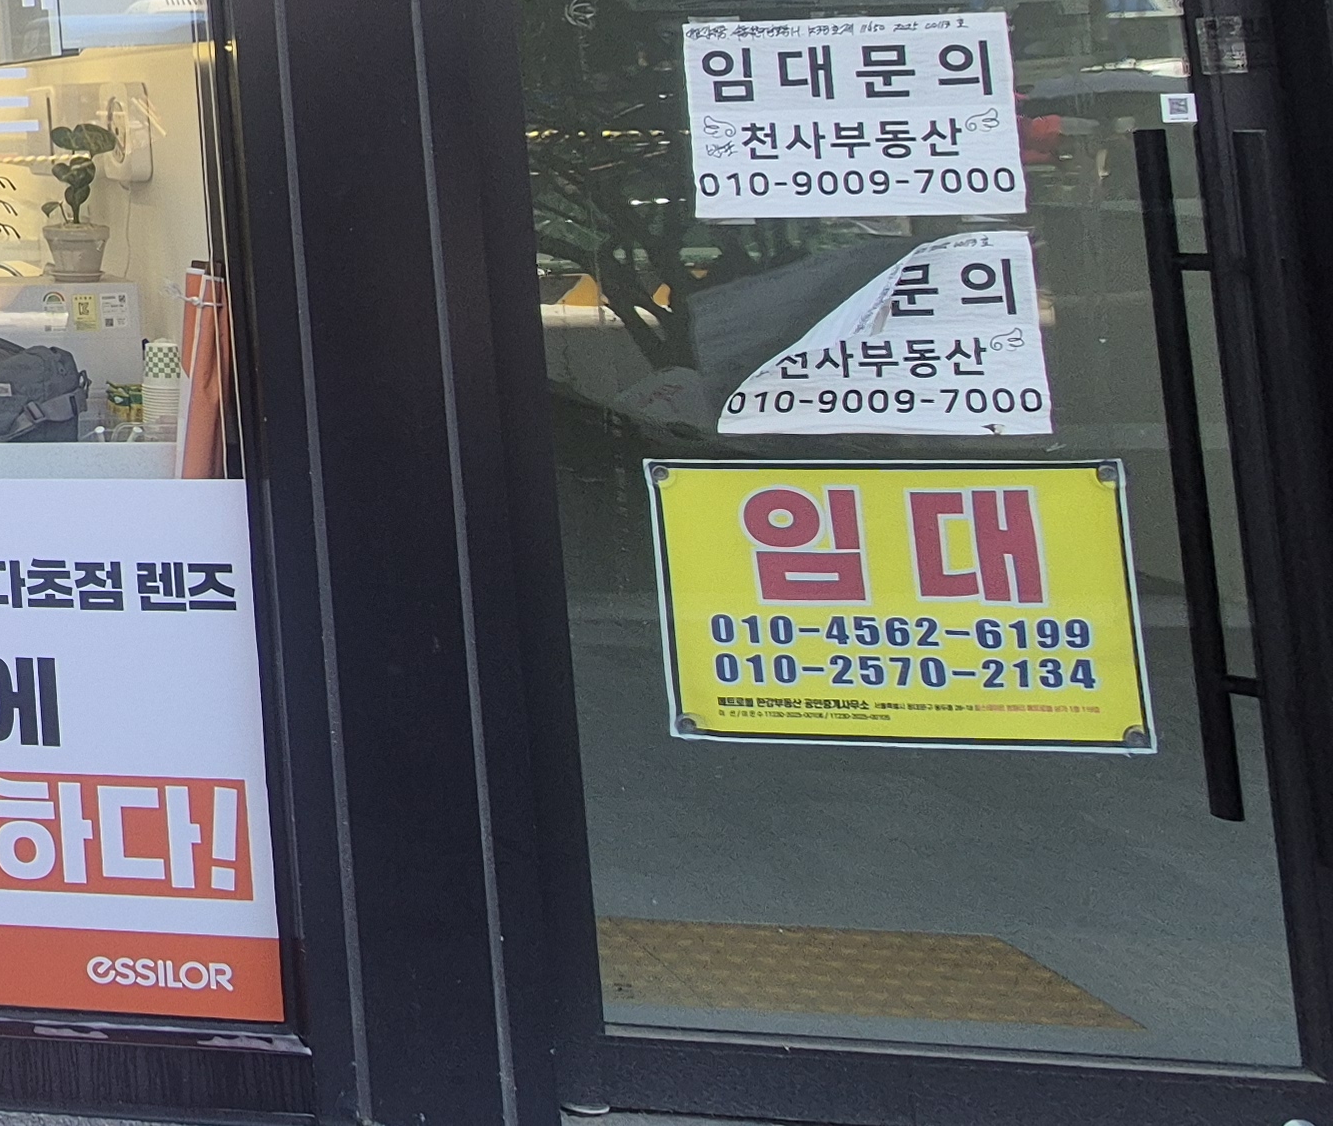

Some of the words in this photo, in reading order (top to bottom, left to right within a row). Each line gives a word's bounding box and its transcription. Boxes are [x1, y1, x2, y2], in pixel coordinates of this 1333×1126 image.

[741, 117, 962, 160] 천사부동산
[699, 167, 1017, 198] 010-9009-7000
[727, 387, 1043, 415] 010-9009-7000
[136, 561, 237, 613] 렌즈
[710, 613, 1092, 650] 010-4562-6199
[715, 652, 1097, 690] 010-2570-2134
